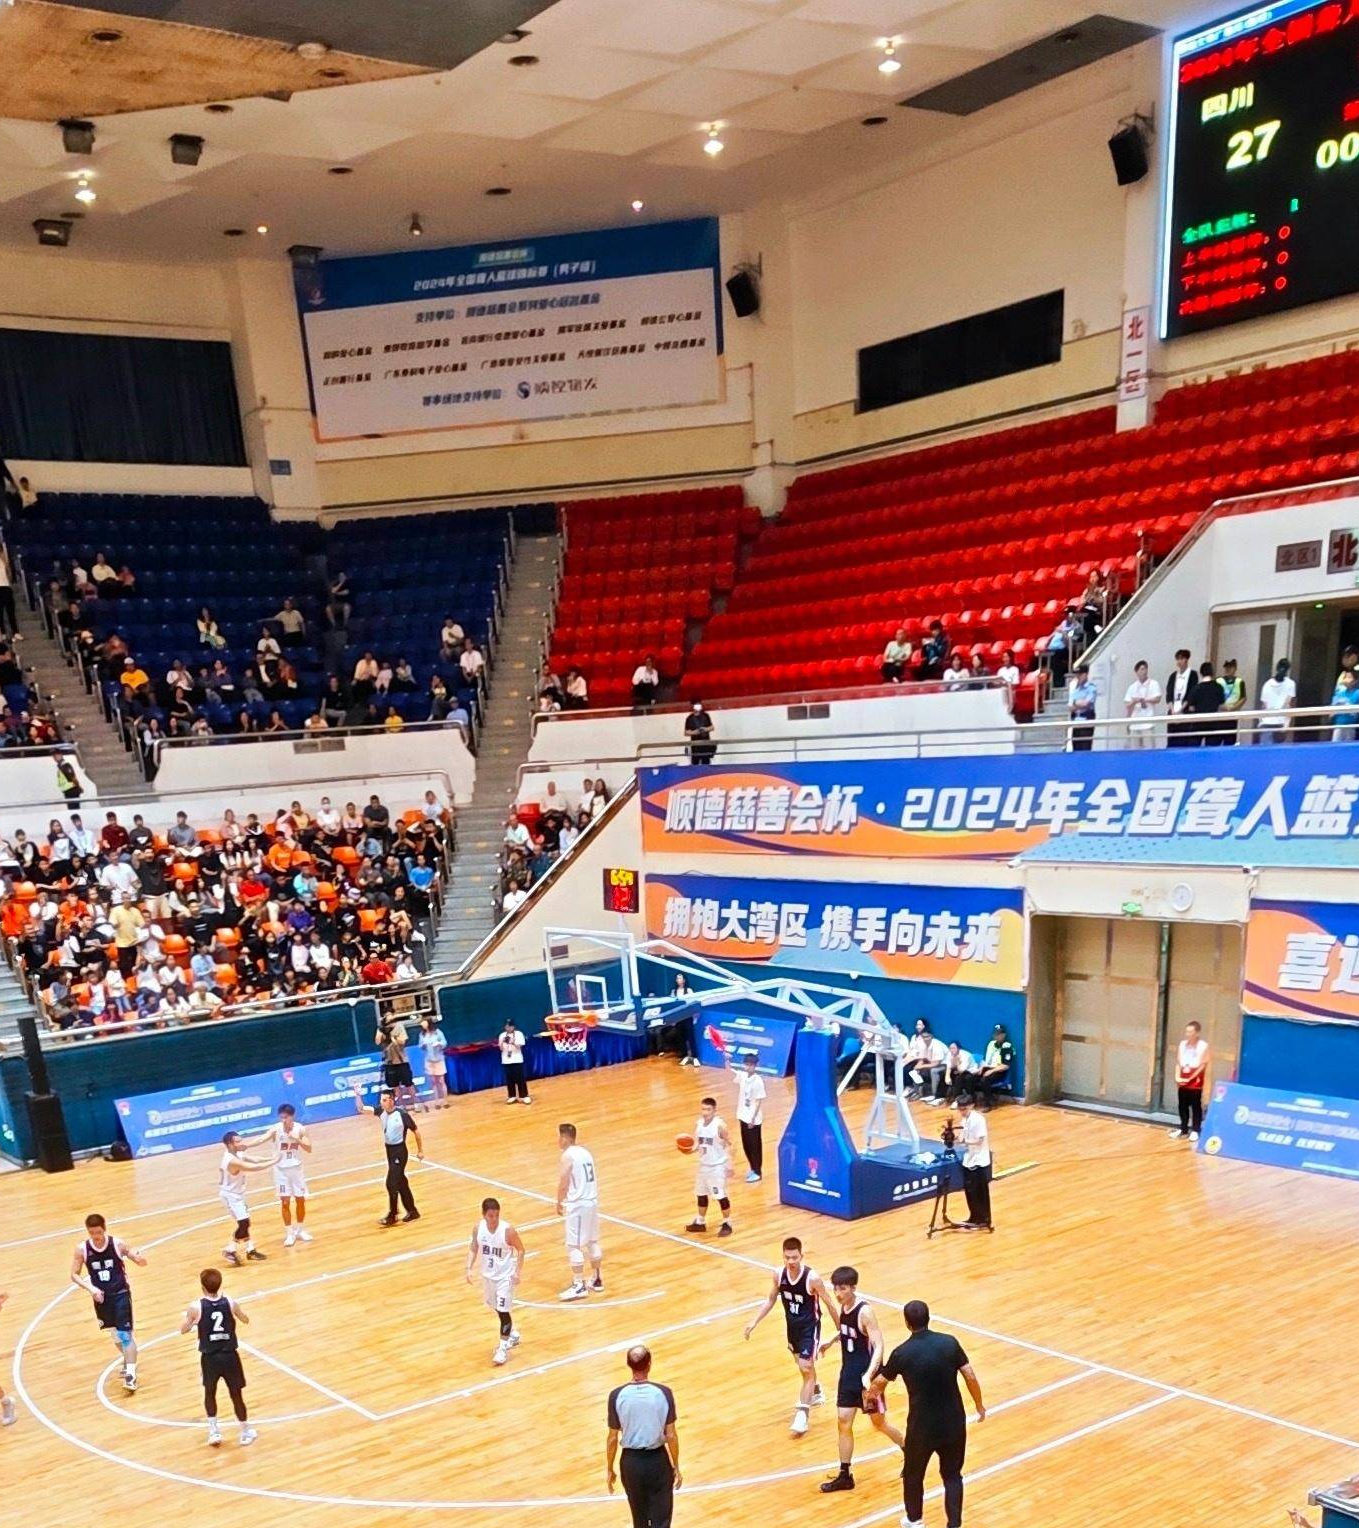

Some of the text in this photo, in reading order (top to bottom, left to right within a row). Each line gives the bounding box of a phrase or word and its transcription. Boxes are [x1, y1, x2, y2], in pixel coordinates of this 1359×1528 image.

[1201, 82, 1255, 123] 四川
[1225, 120, 1281, 170] 27
[663, 895, 1001, 964] 拥抱大湾区 携手向未来
[211, 1311, 224, 1331] 2
